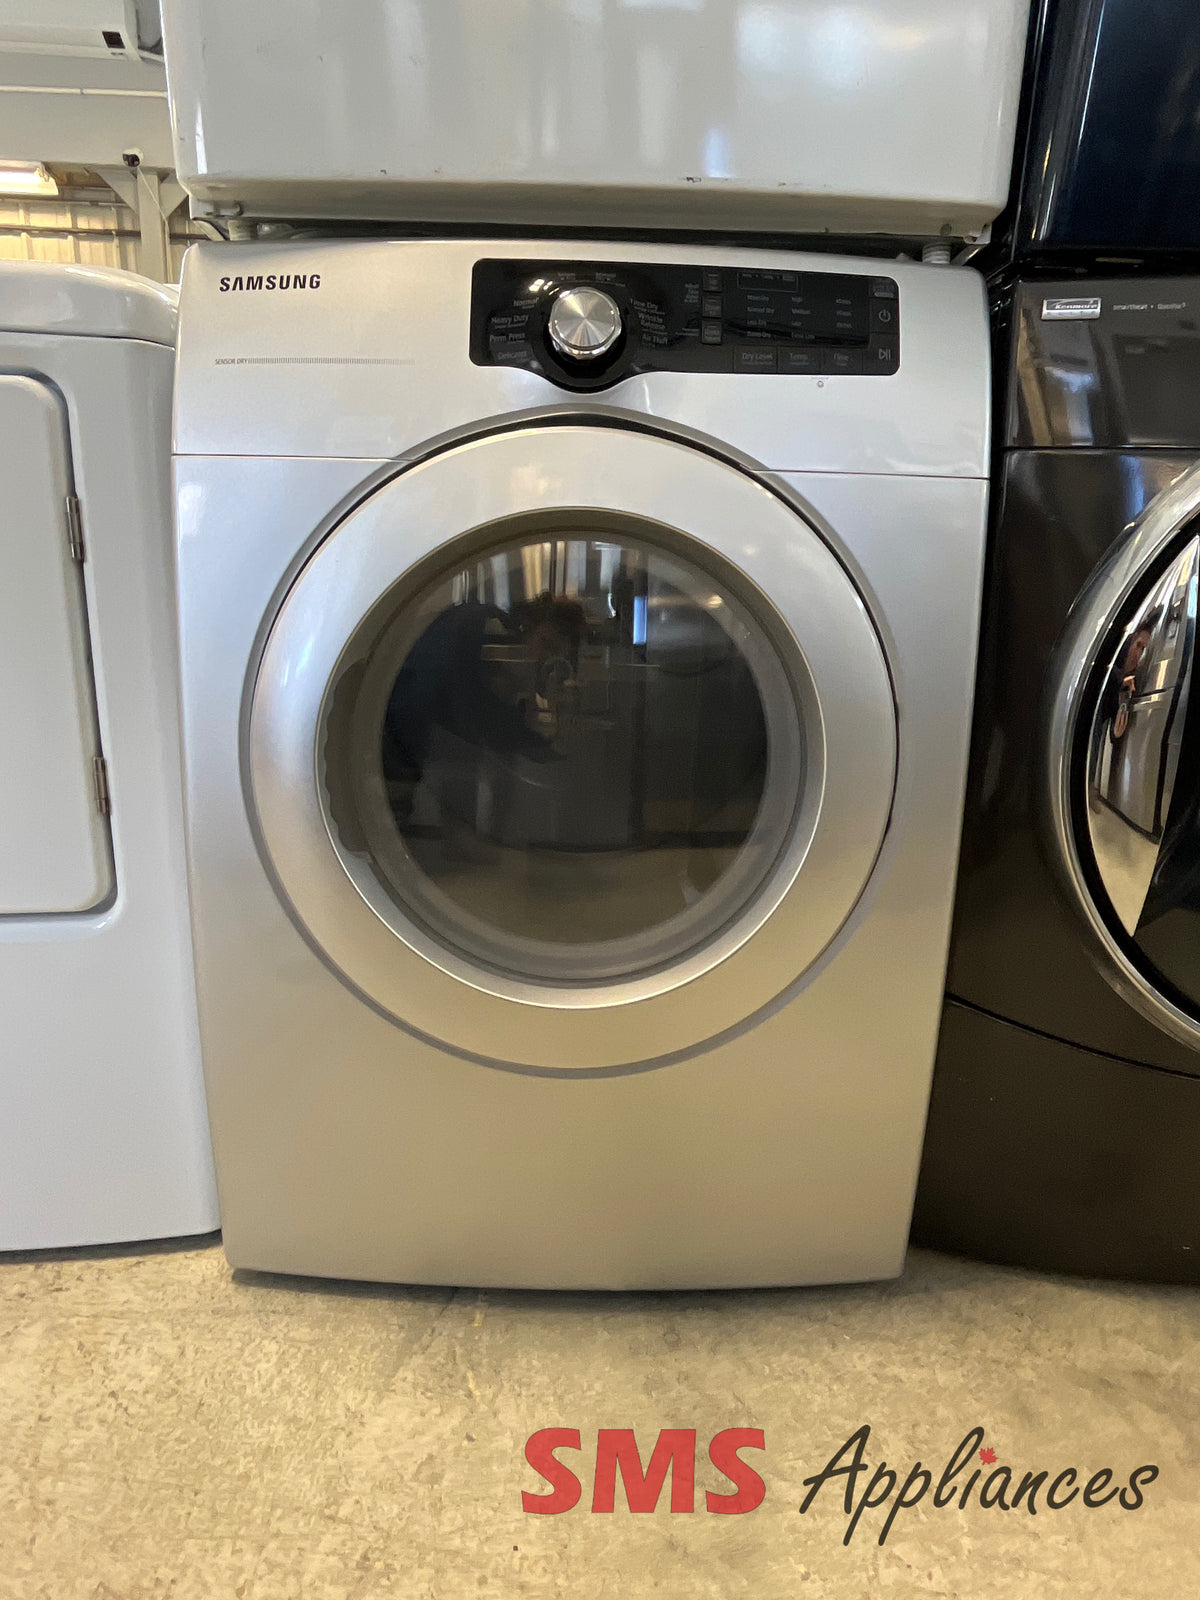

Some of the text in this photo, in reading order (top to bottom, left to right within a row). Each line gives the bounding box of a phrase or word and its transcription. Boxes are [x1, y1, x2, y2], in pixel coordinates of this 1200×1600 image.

[219, 274, 321, 292] SAMSUNG
[1054, 302, 1098, 310] Kenmore
[491, 314, 529, 325] Heavy Duty
[490, 334, 507, 342] Perm
[237, 357, 248, 365] DRY
